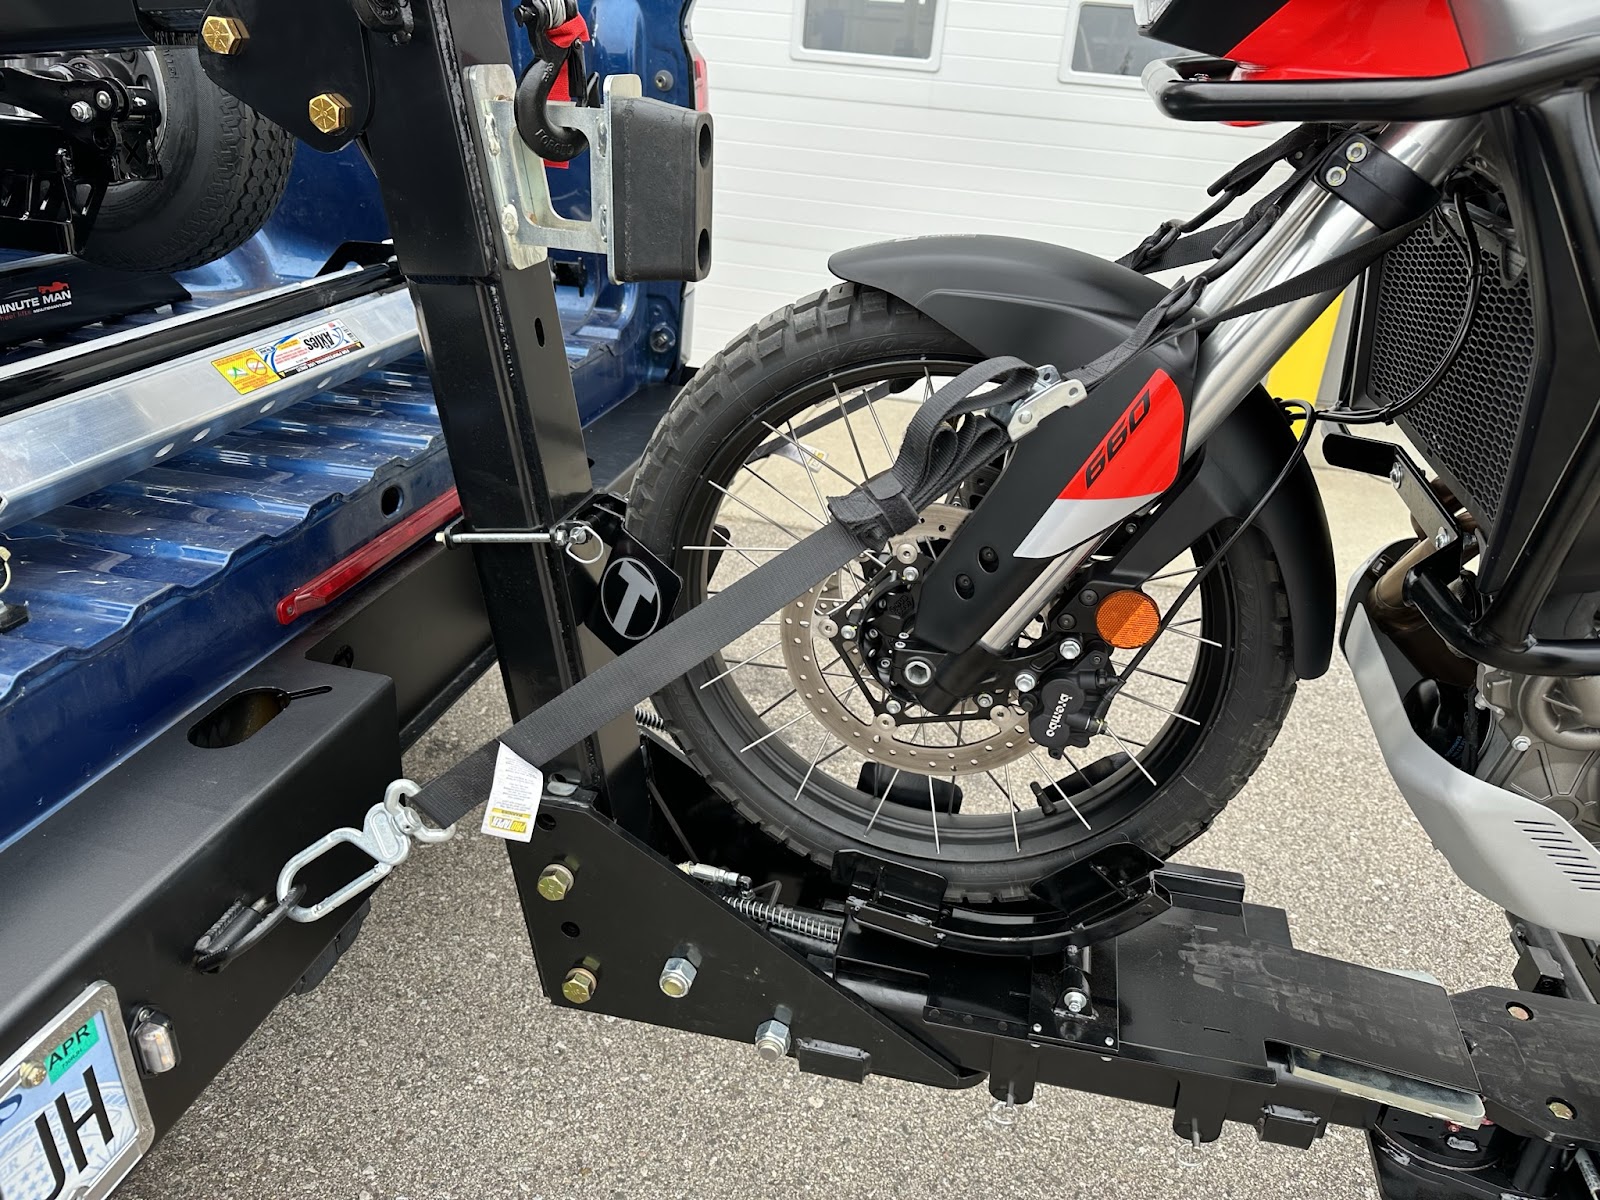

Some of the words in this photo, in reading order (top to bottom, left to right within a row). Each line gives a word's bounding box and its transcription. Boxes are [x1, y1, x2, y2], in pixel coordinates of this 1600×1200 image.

[534, 128, 575, 155] FORGED
[43, 290, 72, 304] MAN
[1085, 388, 1151, 490] 660
[1045, 692, 1073, 738] brembo
[511, 820, 527, 833] PRO
[49, 1023, 91, 1071] APR
